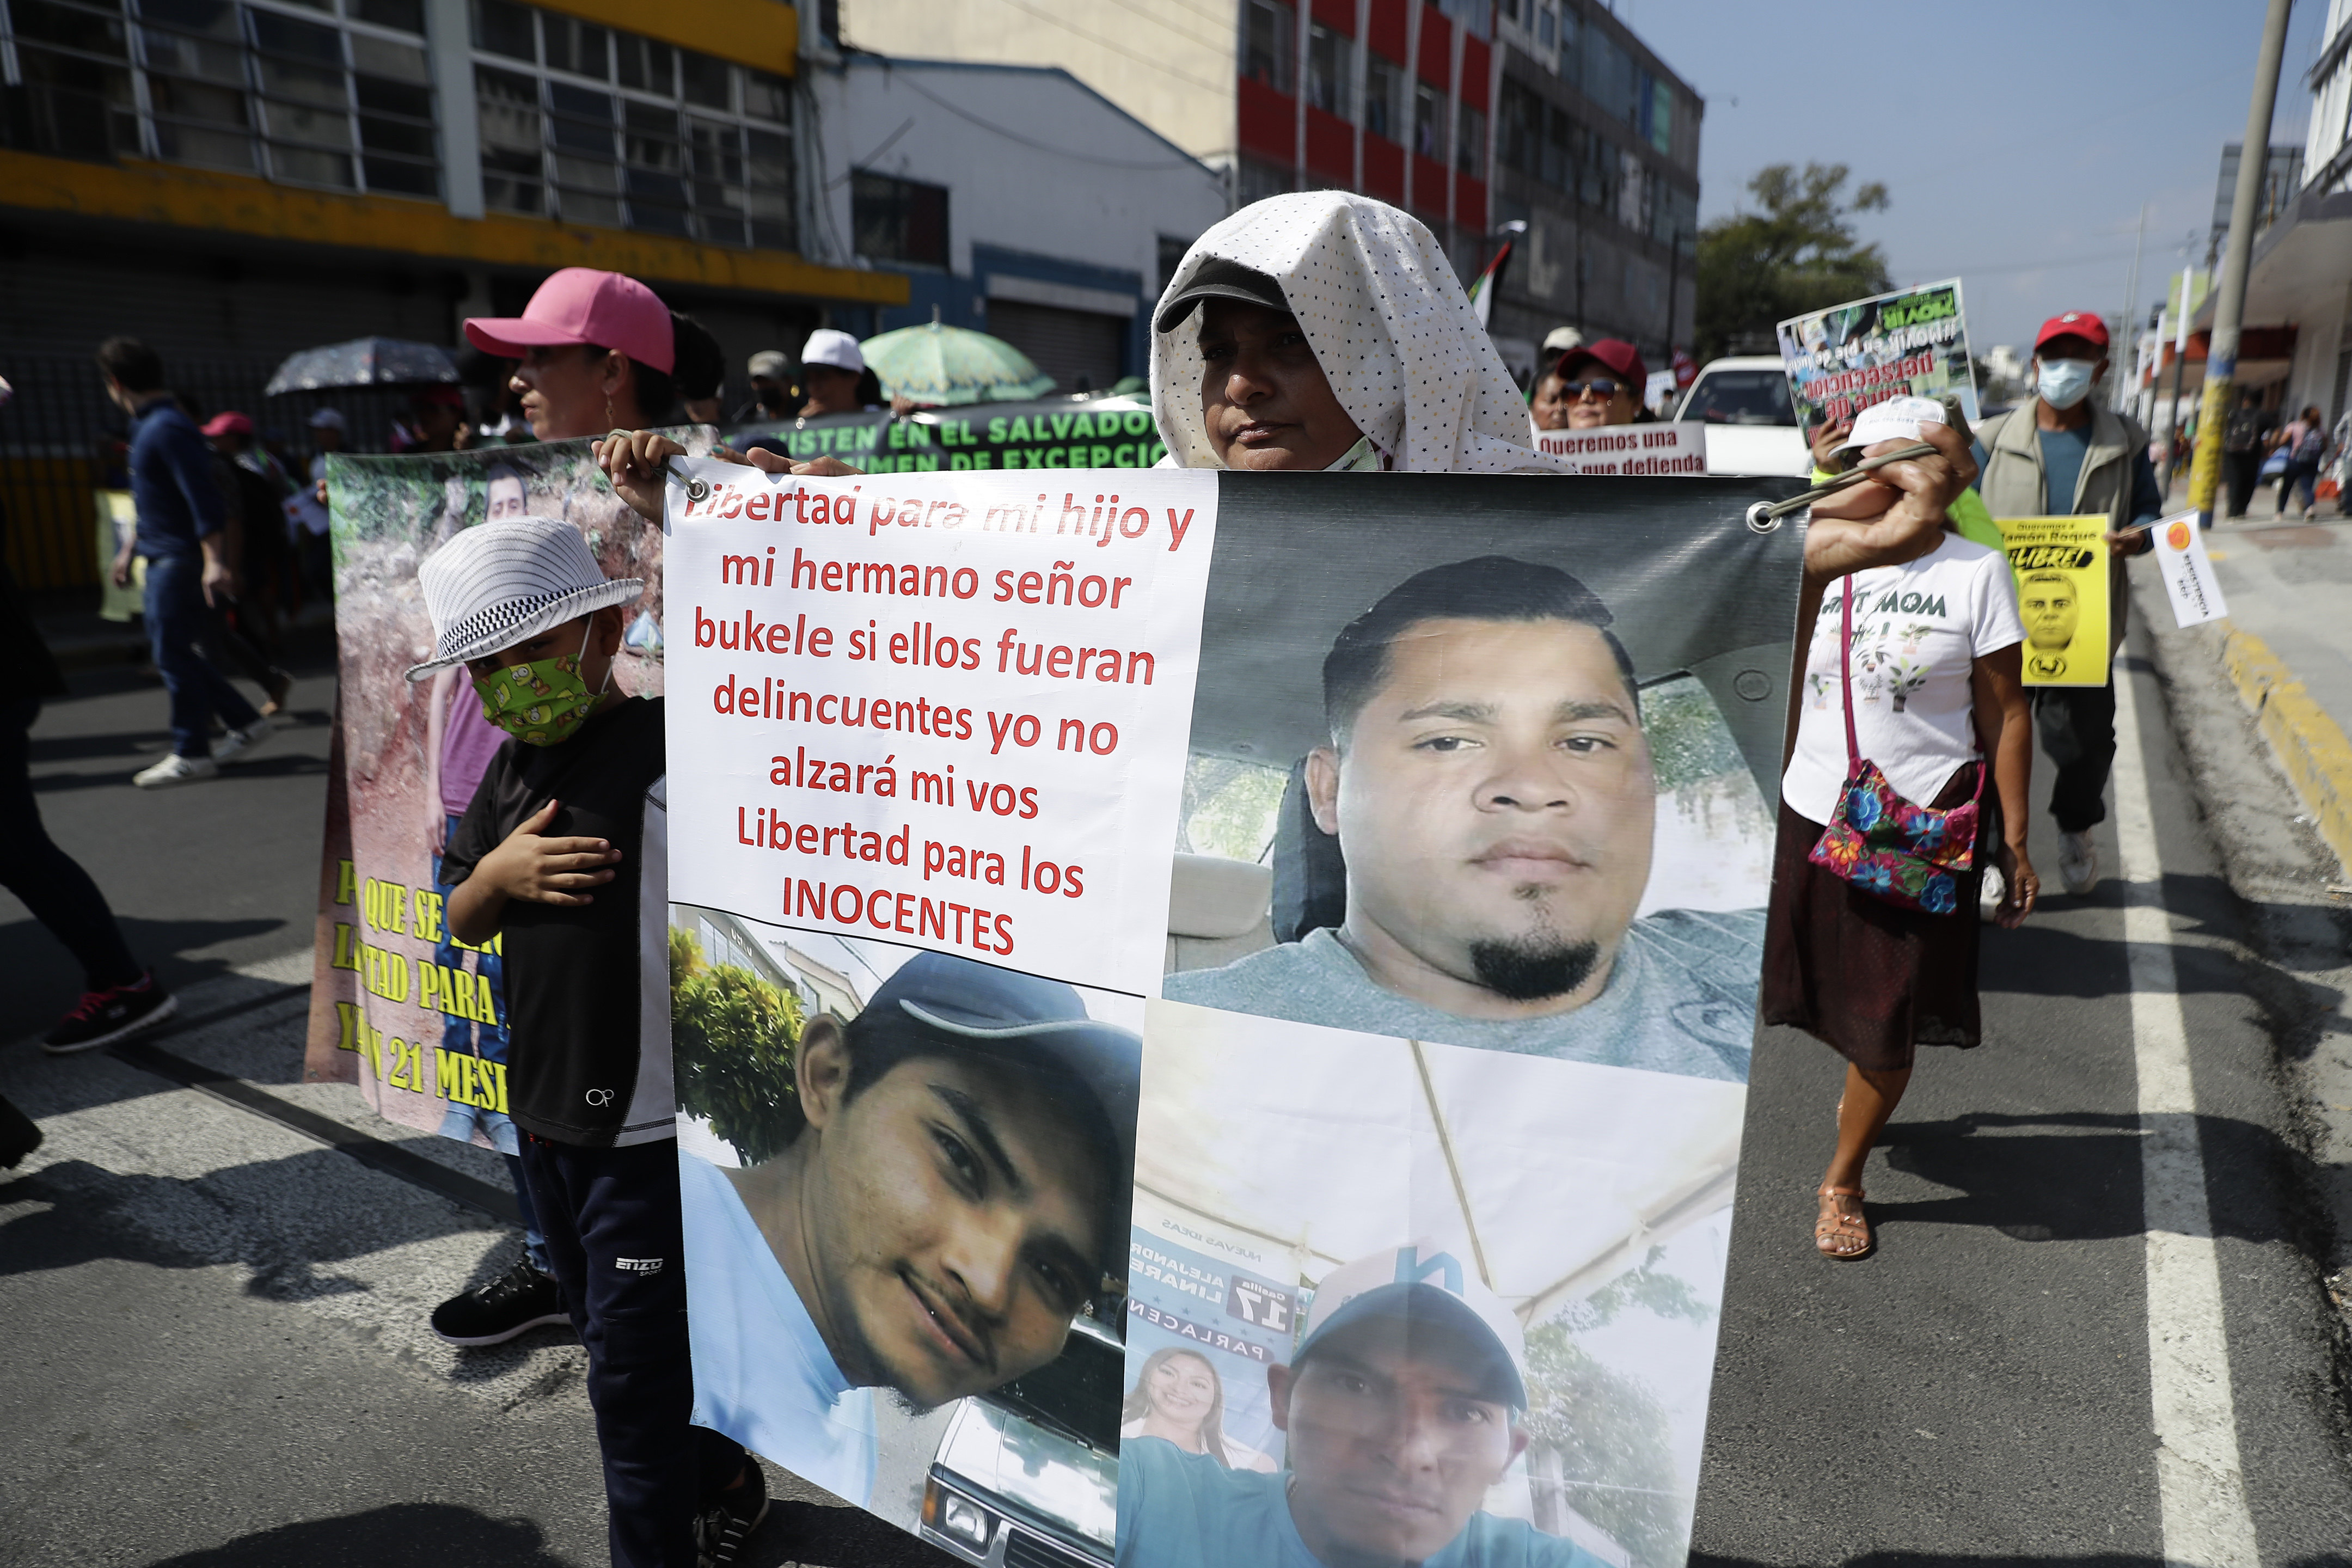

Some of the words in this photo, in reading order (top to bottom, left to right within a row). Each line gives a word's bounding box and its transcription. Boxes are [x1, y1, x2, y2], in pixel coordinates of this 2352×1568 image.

[1882, 290, 1956, 330] MOVIR
[889, 420, 932, 449] EN
[940, 419, 978, 447] EL
[951, 450, 991, 470] DE
[1540, 434, 1638, 455] Queremos
[1643, 429, 1677, 448] una
[1622, 453, 1704, 475] defienda
[871, 499, 966, 536] para
[982, 493, 1046, 534] mi
[1057, 493, 1149, 548] hijo
[1167, 507, 1195, 552] y
[2002, 531, 2044, 542] amón
[2050, 530, 2097, 543] Roque
[722, 546, 776, 587] mi
[791, 547, 978, 599] hermano
[994, 560, 1132, 609] señor
[695, 606, 834, 658] bukele
[848, 620, 876, 661] si
[890, 621, 981, 670] ellos
[997, 628, 1155, 685] fueran
[714, 673, 972, 740] delincuentes
[988, 712, 1041, 755] yo
[1058, 719, 1118, 755] no
[770, 746, 896, 798] alzará
[912, 764, 954, 807] mi
[967, 780, 1039, 819] vos
[738, 806, 910, 866] Libertad
[924, 840, 1004, 886] para
[1021, 845, 1084, 898] los
[364, 877, 406, 933] QUE
[413, 888, 443, 944] SE
[783, 877, 1014, 955] INOCENTES
[417, 960, 498, 1026] PARA
[388, 1037, 423, 1093] 21
